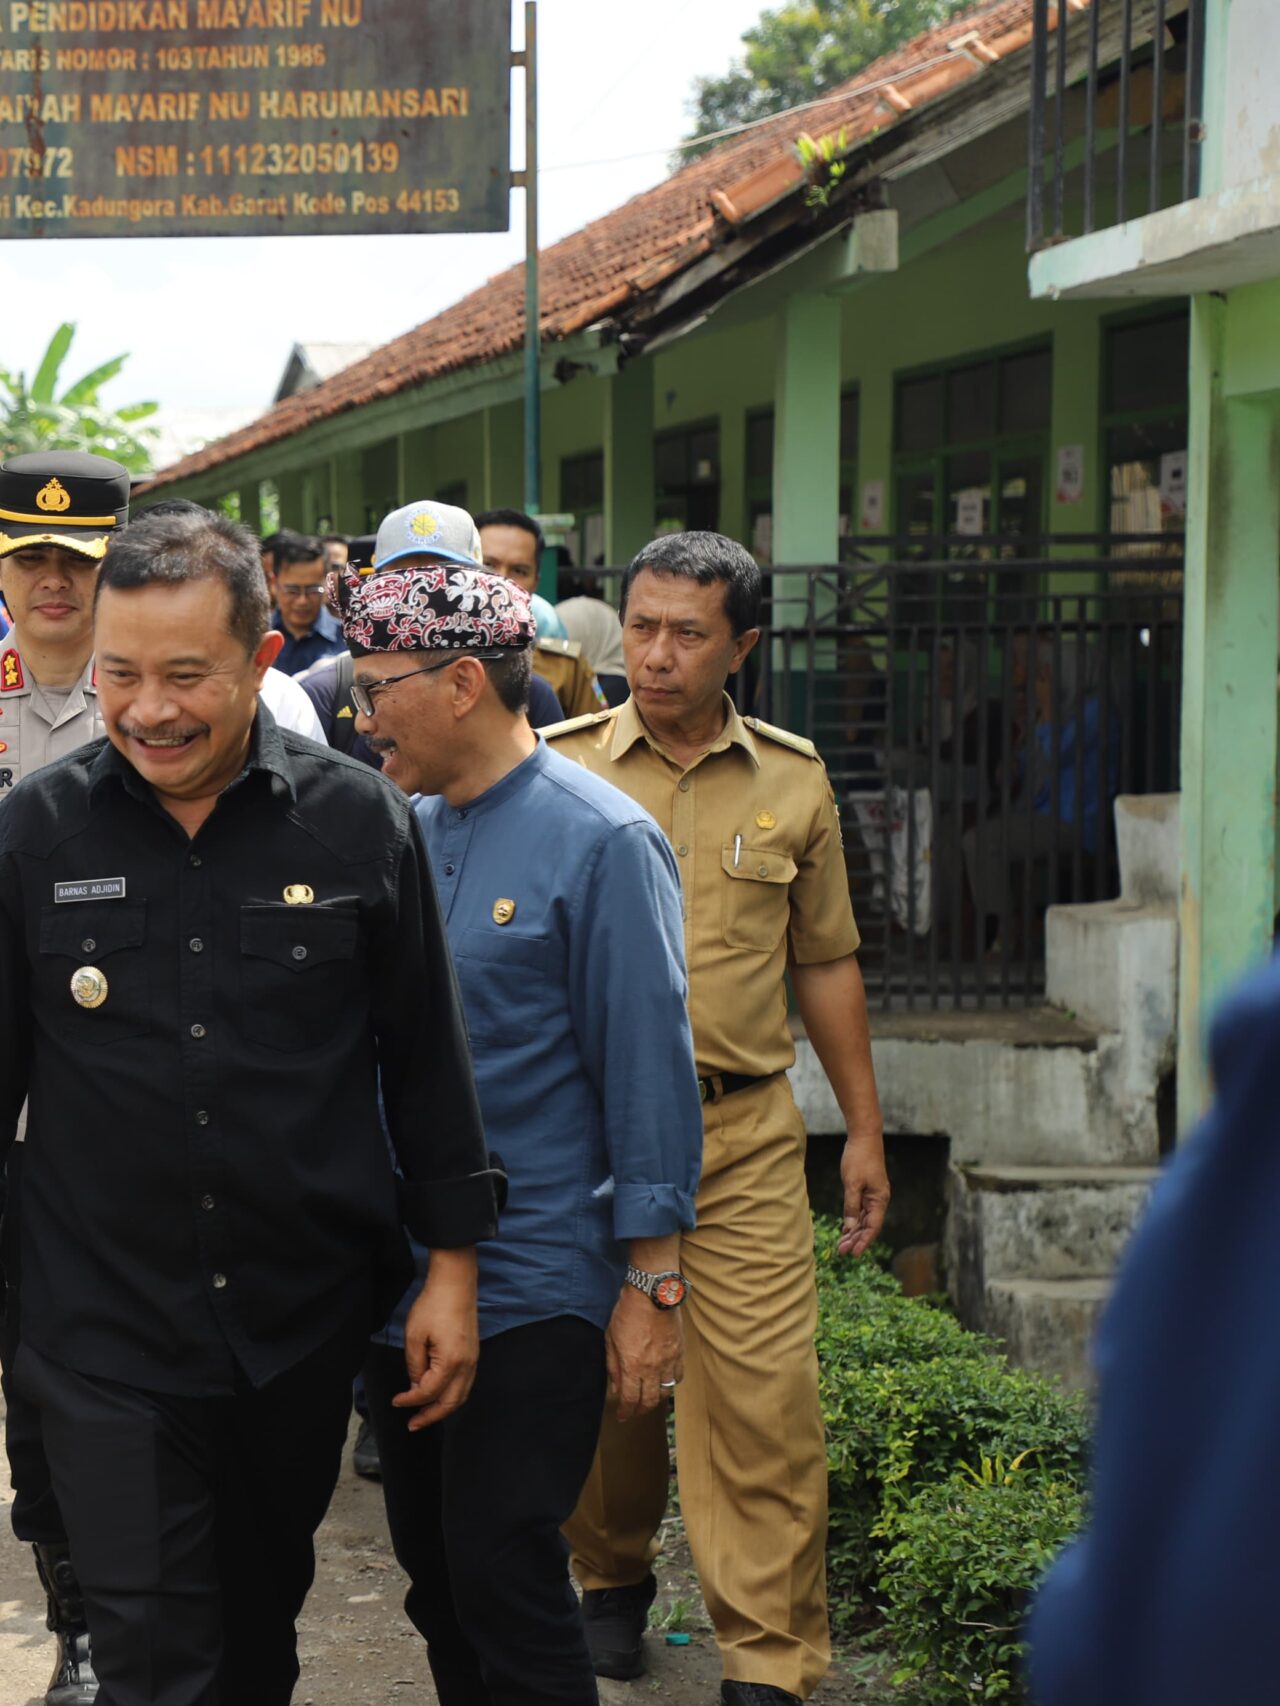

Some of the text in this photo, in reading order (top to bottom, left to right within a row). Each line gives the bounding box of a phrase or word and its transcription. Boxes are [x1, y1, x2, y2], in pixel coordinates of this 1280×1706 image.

[10, 0, 189, 33] PENDIDIKAN
[196, 0, 312, 30] MA'ARIF
[321, 0, 363, 28] NU
[56, 47, 137, 71] NOMOR
[155, 47, 192, 71] 103
[194, 45, 269, 70] TAHUN
[89, 91, 201, 123] MA'ARIF
[208, 90, 251, 121] NU
[258, 87, 469, 119] HARUMANSARI
[114, 144, 179, 177] NSM
[292, 191, 347, 216] Kode
[350, 190, 391, 215] Pos
[395, 188, 462, 213] 44153
[58, 883, 121, 897] BARNAS ADJIDIN
